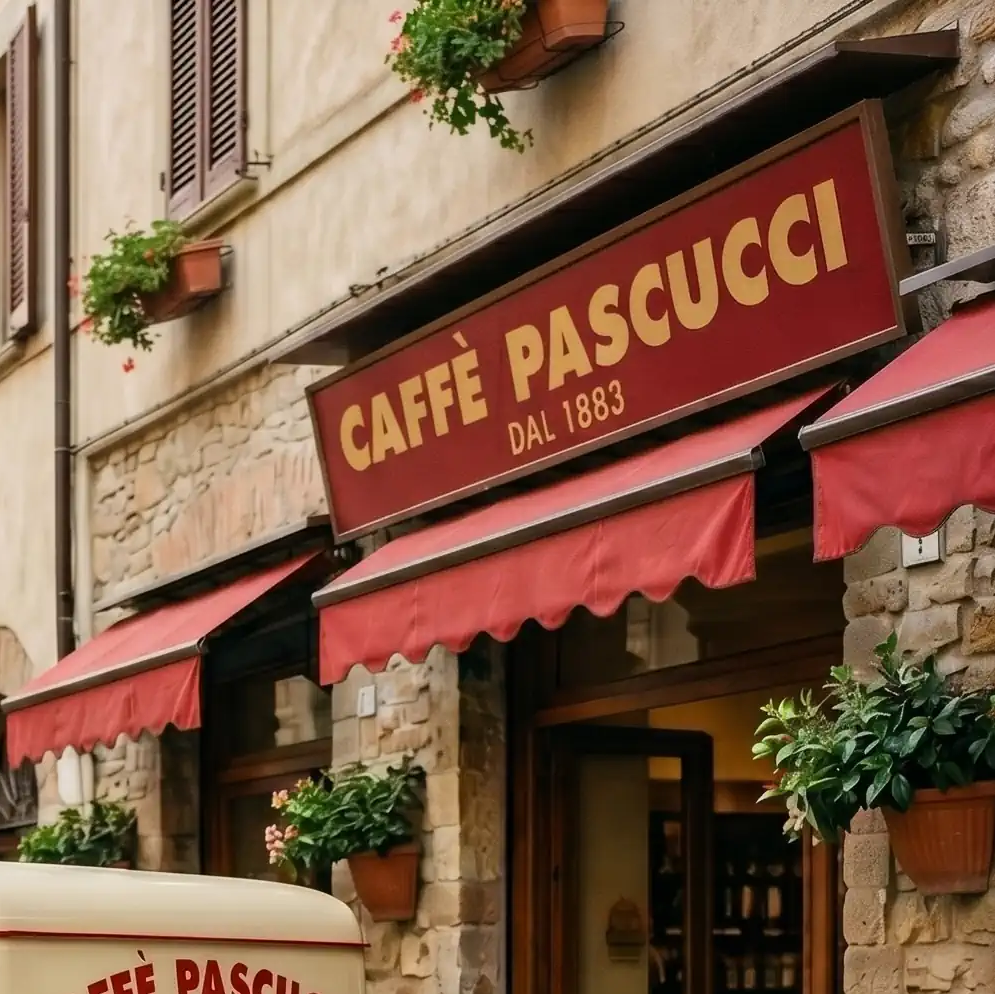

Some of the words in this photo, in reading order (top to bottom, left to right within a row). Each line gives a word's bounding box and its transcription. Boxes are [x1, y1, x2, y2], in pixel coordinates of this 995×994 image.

[340, 332, 488, 472] CAFFÈ
[505, 178, 848, 402] PASCUCCI
[508, 411, 556, 456] DAL
[566, 380, 625, 435] 1883
